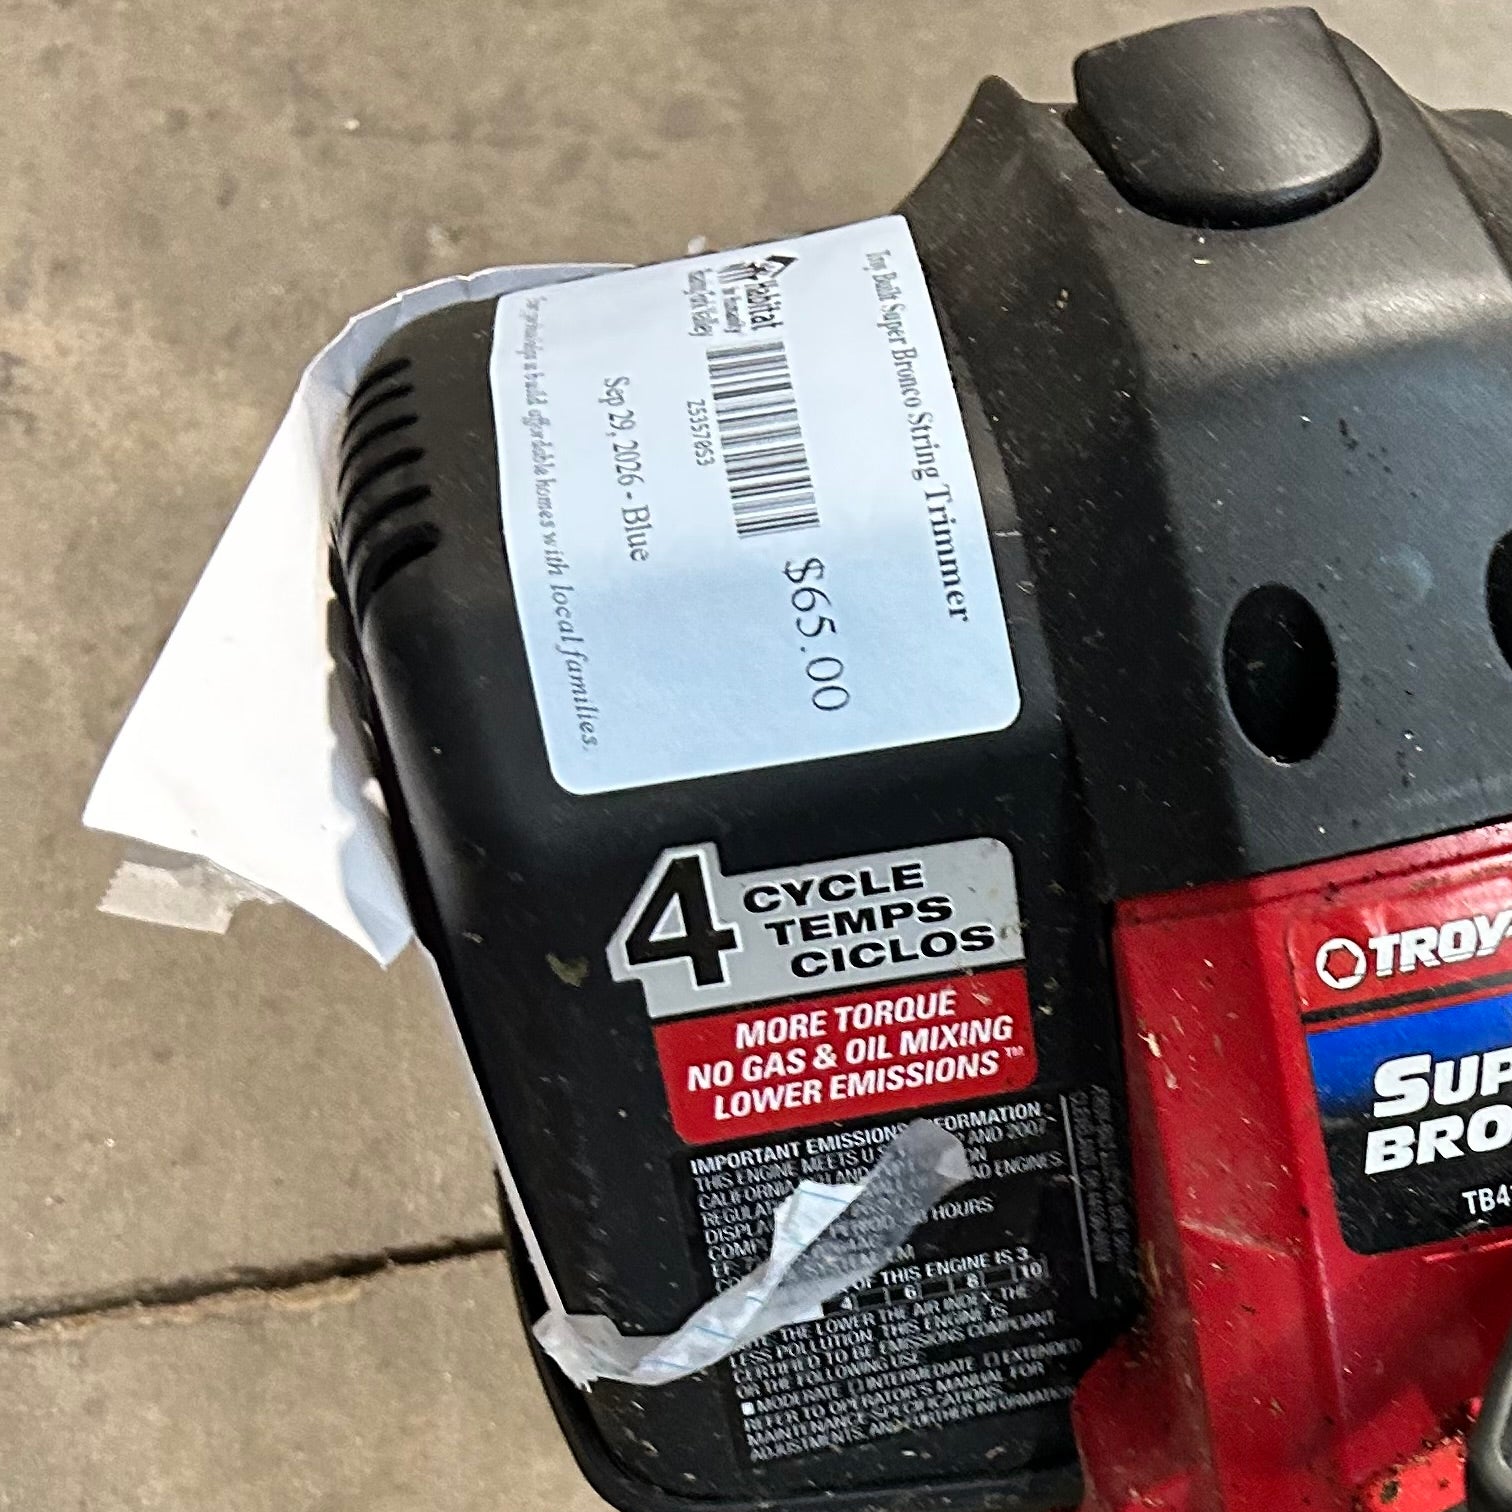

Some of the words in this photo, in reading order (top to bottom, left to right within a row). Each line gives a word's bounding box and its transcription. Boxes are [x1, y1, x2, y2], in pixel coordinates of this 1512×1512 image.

[876, 303, 908, 346] Super
[598, 375, 631, 407] Sep
[891, 347, 923, 408] Bronco
[521, 408, 556, 477] affordable
[605, 409, 637, 438] 29,
[908, 411, 941, 482] String
[613, 439, 646, 487] 2026
[536, 478, 557, 528] homes
[543, 530, 570, 576] with
[620, 504, 654, 562] Blue
[924, 482, 969, 623] Trimmer
[550, 583, 585, 643] local
[782, 558, 851, 712] $65.00
[556, 642, 600, 753] families.
[743, 862, 925, 914] CYCLE
[624, 853, 740, 988] 4
[765, 895, 954, 947] TEMPS
[790, 924, 996, 979] CICLOS
[735, 1008, 829, 1050] MORE
[835, 989, 958, 1033] TORQUE
[687, 1059, 734, 1092] NO
[742, 1049, 808, 1083] GAS
[812, 1042, 838, 1069] &
[845, 1036, 891, 1064] OIL
[899, 1015, 1014, 1057] MIXING
[713, 1078, 823, 1121] LOWER
[829, 1049, 1001, 1103] EMISSIONS
[689, 1140, 803, 1176] IMPORTANT
[927, 1099, 1043, 1136] FORMATION
[694, 1170, 734, 1194] THIS
[735, 1159, 801, 1186] ENGINE
[800, 1149, 861, 1175] MEETS
[965, 1123, 1004, 1147] AND
[992, 1146, 1065, 1178] ENGINES
[929, 1195, 995, 1223] HOURS
[879, 1264, 922, 1287] THIS
[923, 1250, 994, 1279] ENGINE
[992, 1246, 1014, 1266] IS
[902, 1282, 918, 1301] 6
[1020, 1260, 1044, 1280] 10
[813, 1311, 877, 1337] LOWER
